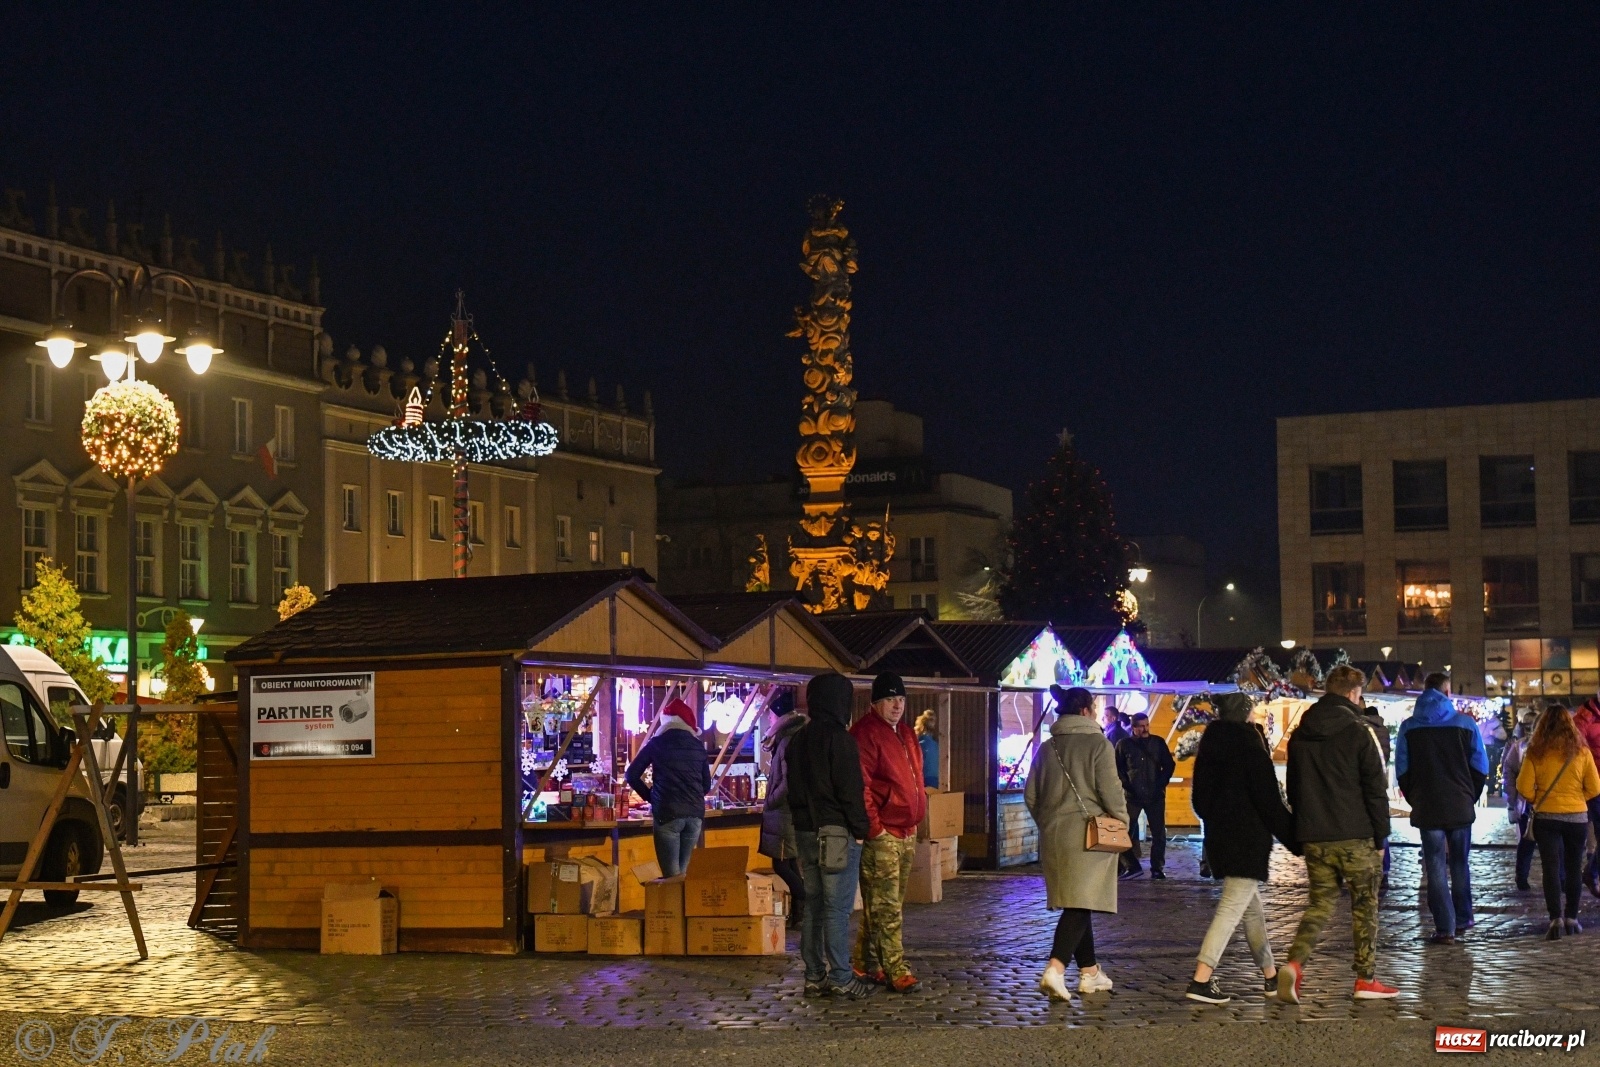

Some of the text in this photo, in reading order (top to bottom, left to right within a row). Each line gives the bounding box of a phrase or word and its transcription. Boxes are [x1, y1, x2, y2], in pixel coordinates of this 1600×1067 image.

[261, 678, 363, 689] OBIEKT MONITOROWANY
[257, 705, 334, 720] PARTNER
[304, 723, 335, 731] system
